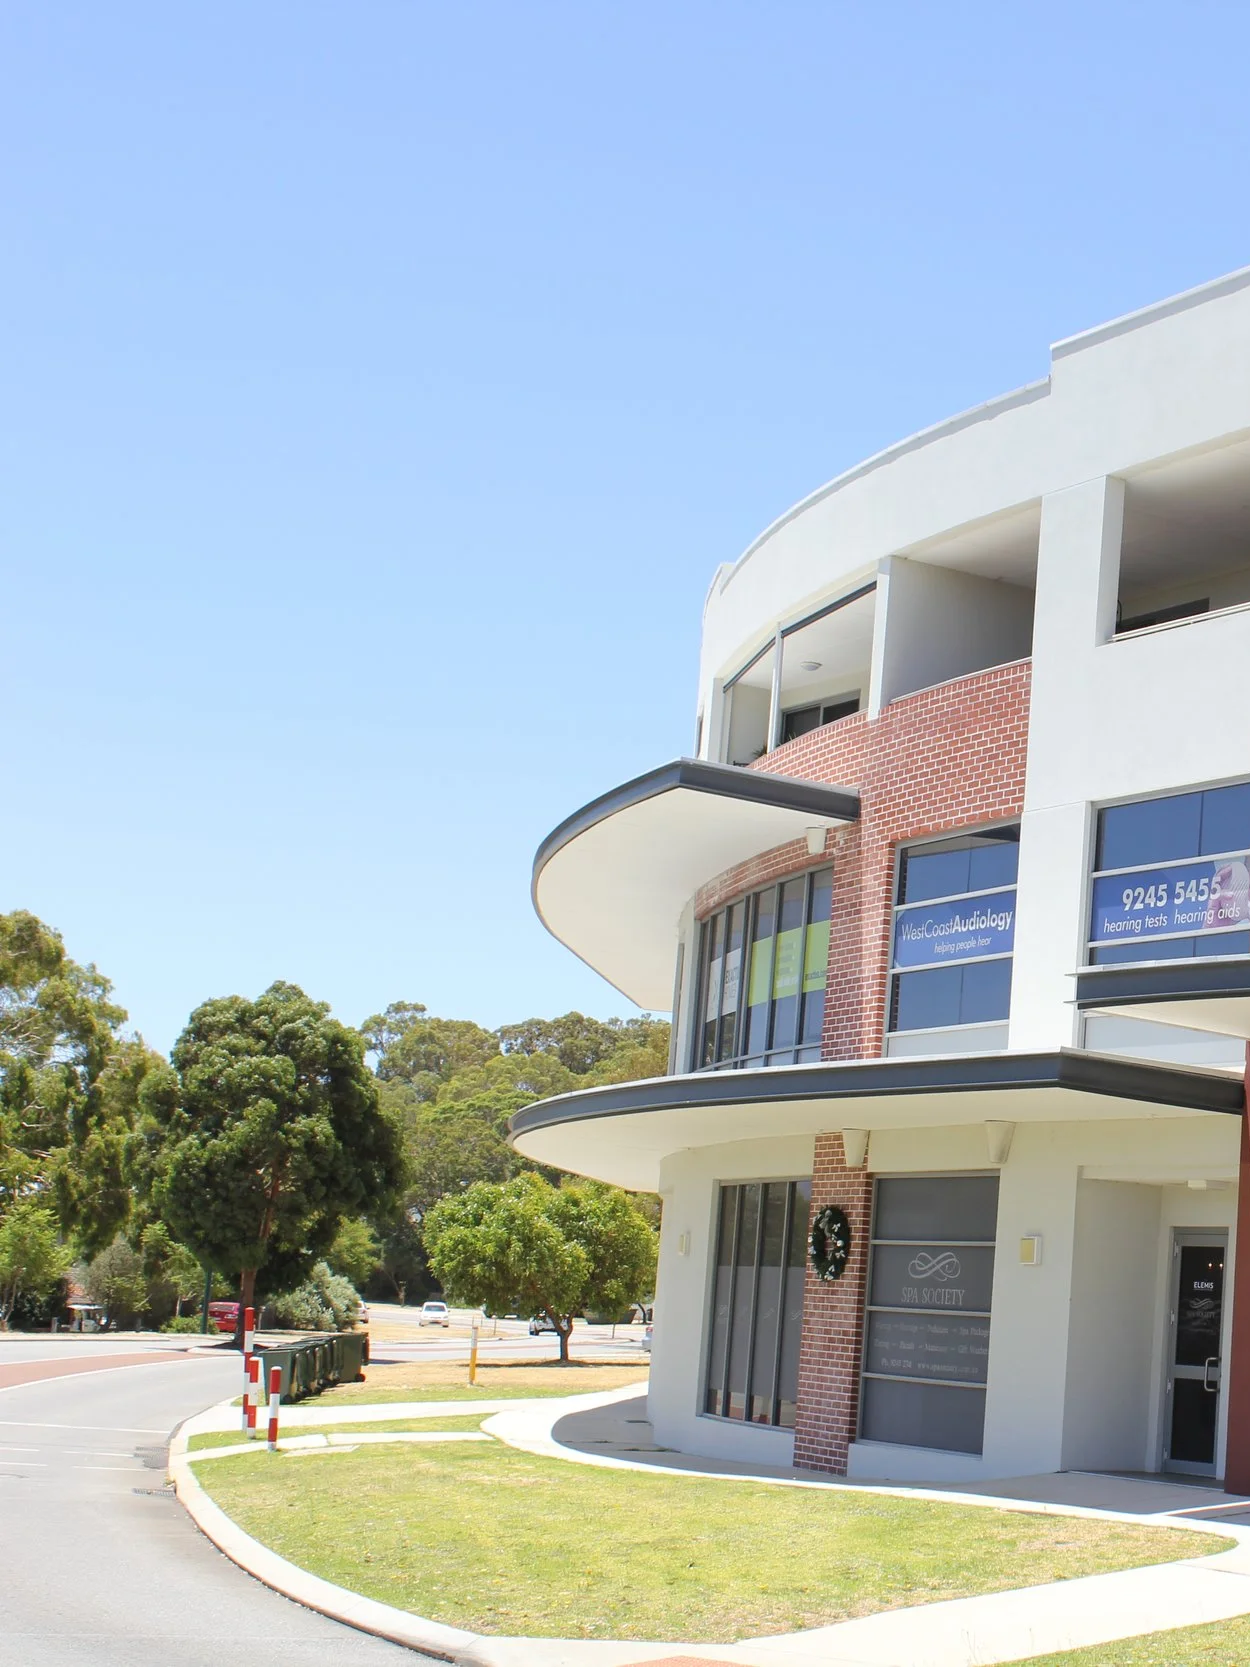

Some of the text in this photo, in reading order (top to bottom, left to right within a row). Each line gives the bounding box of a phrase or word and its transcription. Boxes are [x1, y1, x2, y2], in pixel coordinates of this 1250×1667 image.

[1122, 877, 1222, 911] 9245 5455
[901, 908, 1013, 941] WestCoastAudiology
[1103, 901, 1241, 933] hearing tests hearing aids
[934, 936, 992, 955] helping people hear
[901, 1287, 965, 1306] SPA SOCIETY
[1193, 1281, 1214, 1289] ELEMIS
